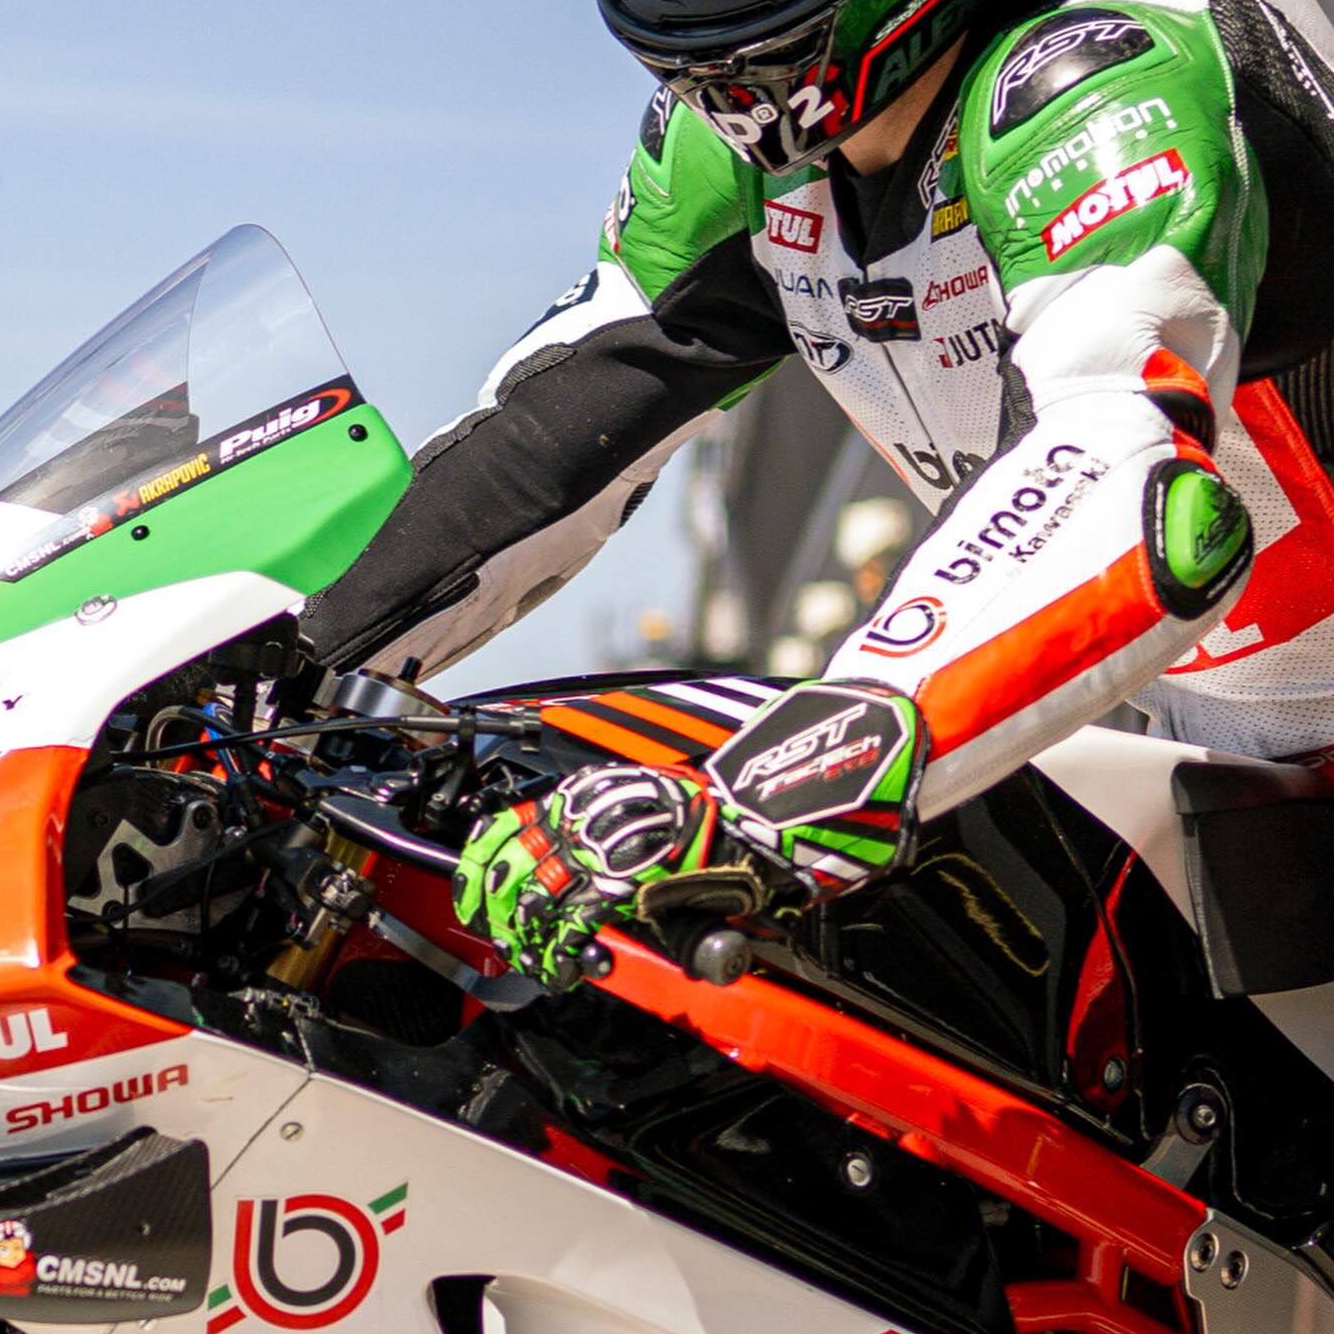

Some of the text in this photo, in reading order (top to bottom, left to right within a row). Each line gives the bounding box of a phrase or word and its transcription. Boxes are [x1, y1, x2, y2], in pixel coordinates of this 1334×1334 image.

[991, 20, 1147, 125] RST
[1050, 153, 1192, 253] MOTUL
[219, 398, 321, 460] Puig
[933, 444, 1086, 585] bimota
[731, 701, 868, 792] RST
[6, 1064, 189, 1134] SHOWA
